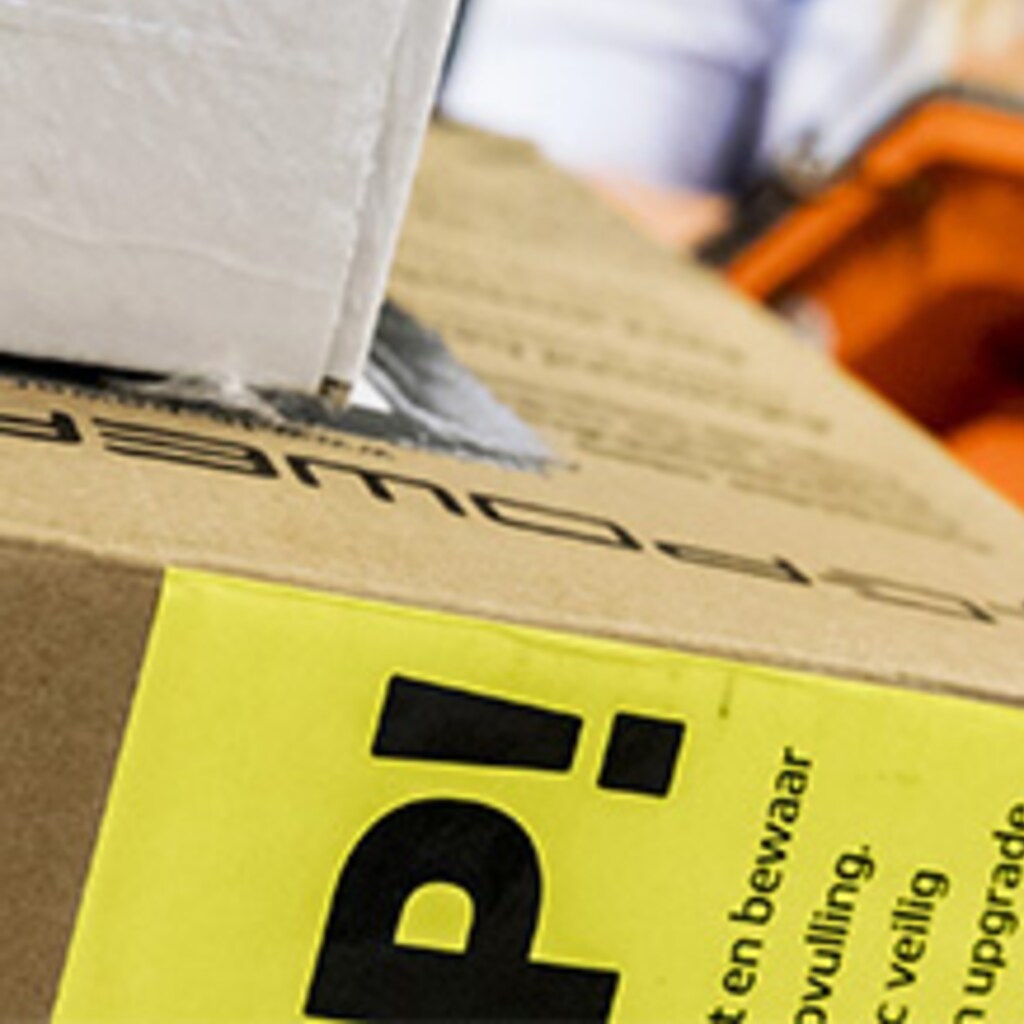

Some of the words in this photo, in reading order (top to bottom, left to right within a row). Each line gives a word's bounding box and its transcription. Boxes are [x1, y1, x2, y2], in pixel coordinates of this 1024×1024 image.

[303, 673, 686, 1024] P!
[729, 747, 812, 926] bewaar
[721, 936, 763, 996] en
[886, 869, 949, 990] veilig
